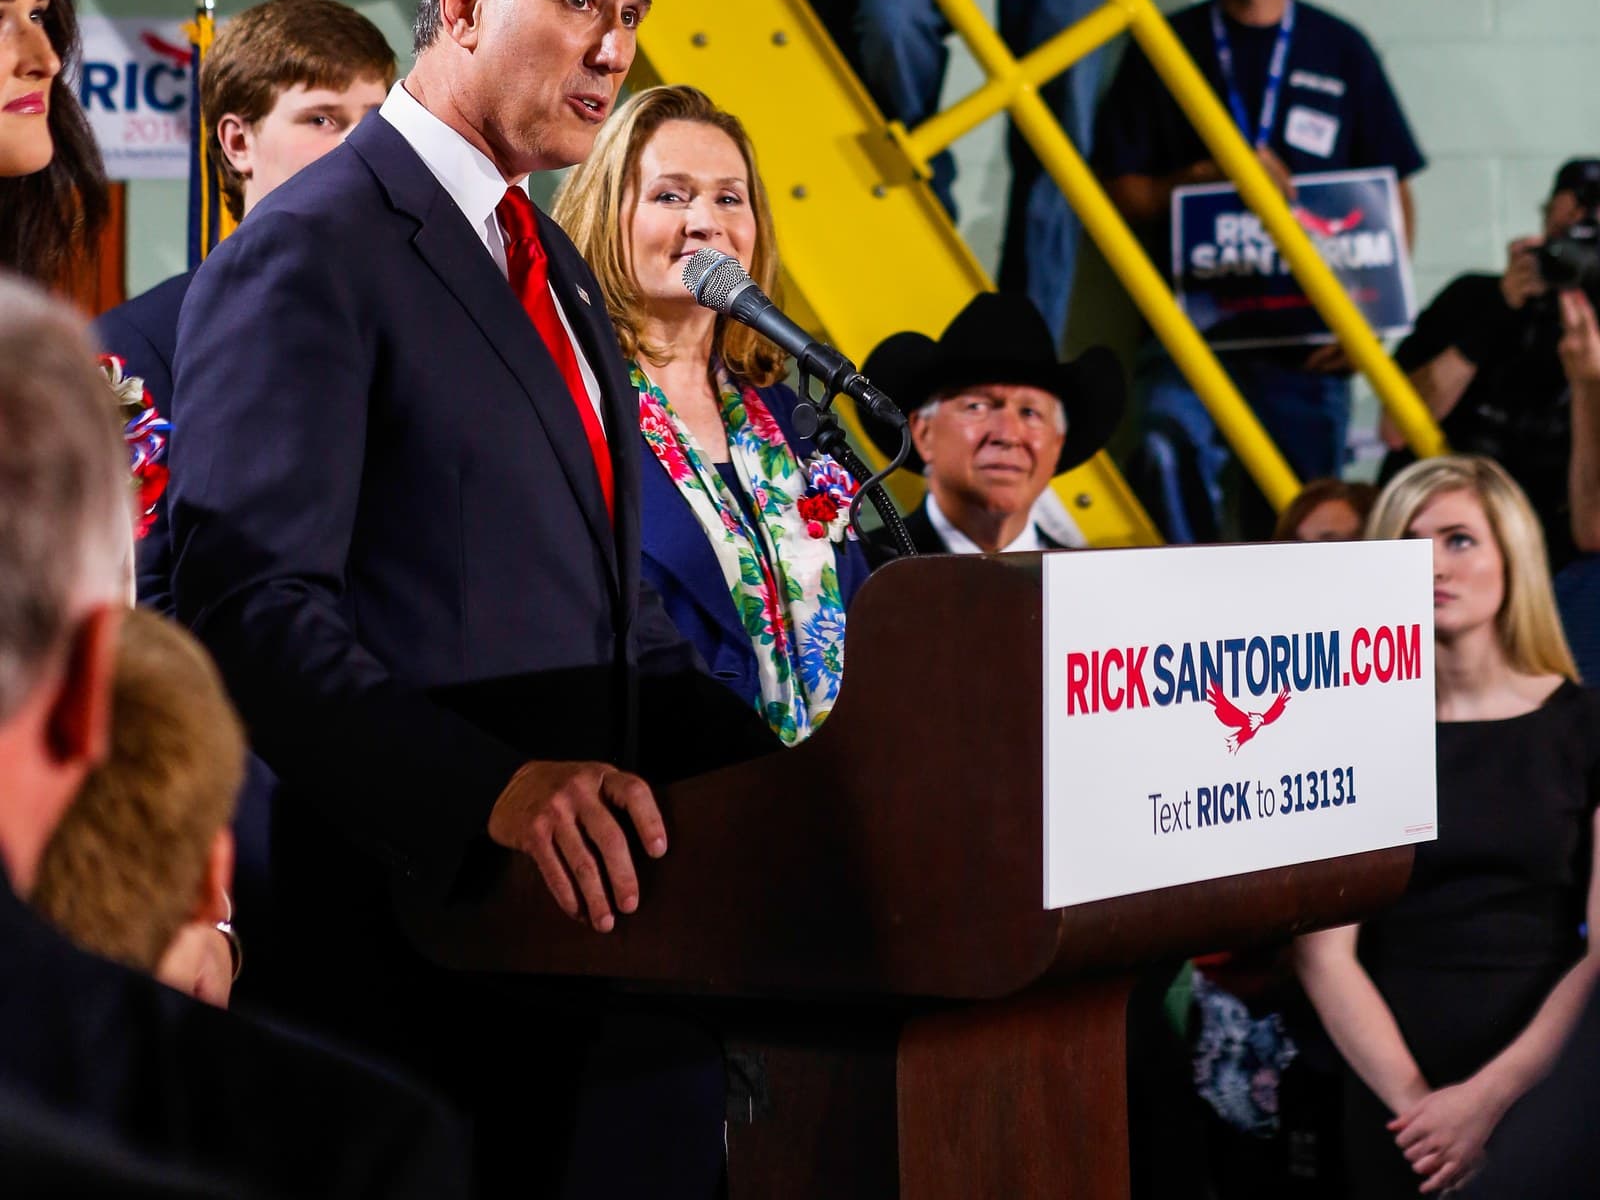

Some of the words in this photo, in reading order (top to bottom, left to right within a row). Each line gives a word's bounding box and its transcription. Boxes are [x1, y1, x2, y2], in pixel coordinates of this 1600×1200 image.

[80, 60, 187, 114] RIC
[1066, 623, 1422, 717] RICKSANTORUM.COM
[1148, 791, 1192, 835] Text
[1197, 780, 1252, 828] RICK
[1256, 780, 1276, 819] to
[1279, 766, 1357, 815] 313131
